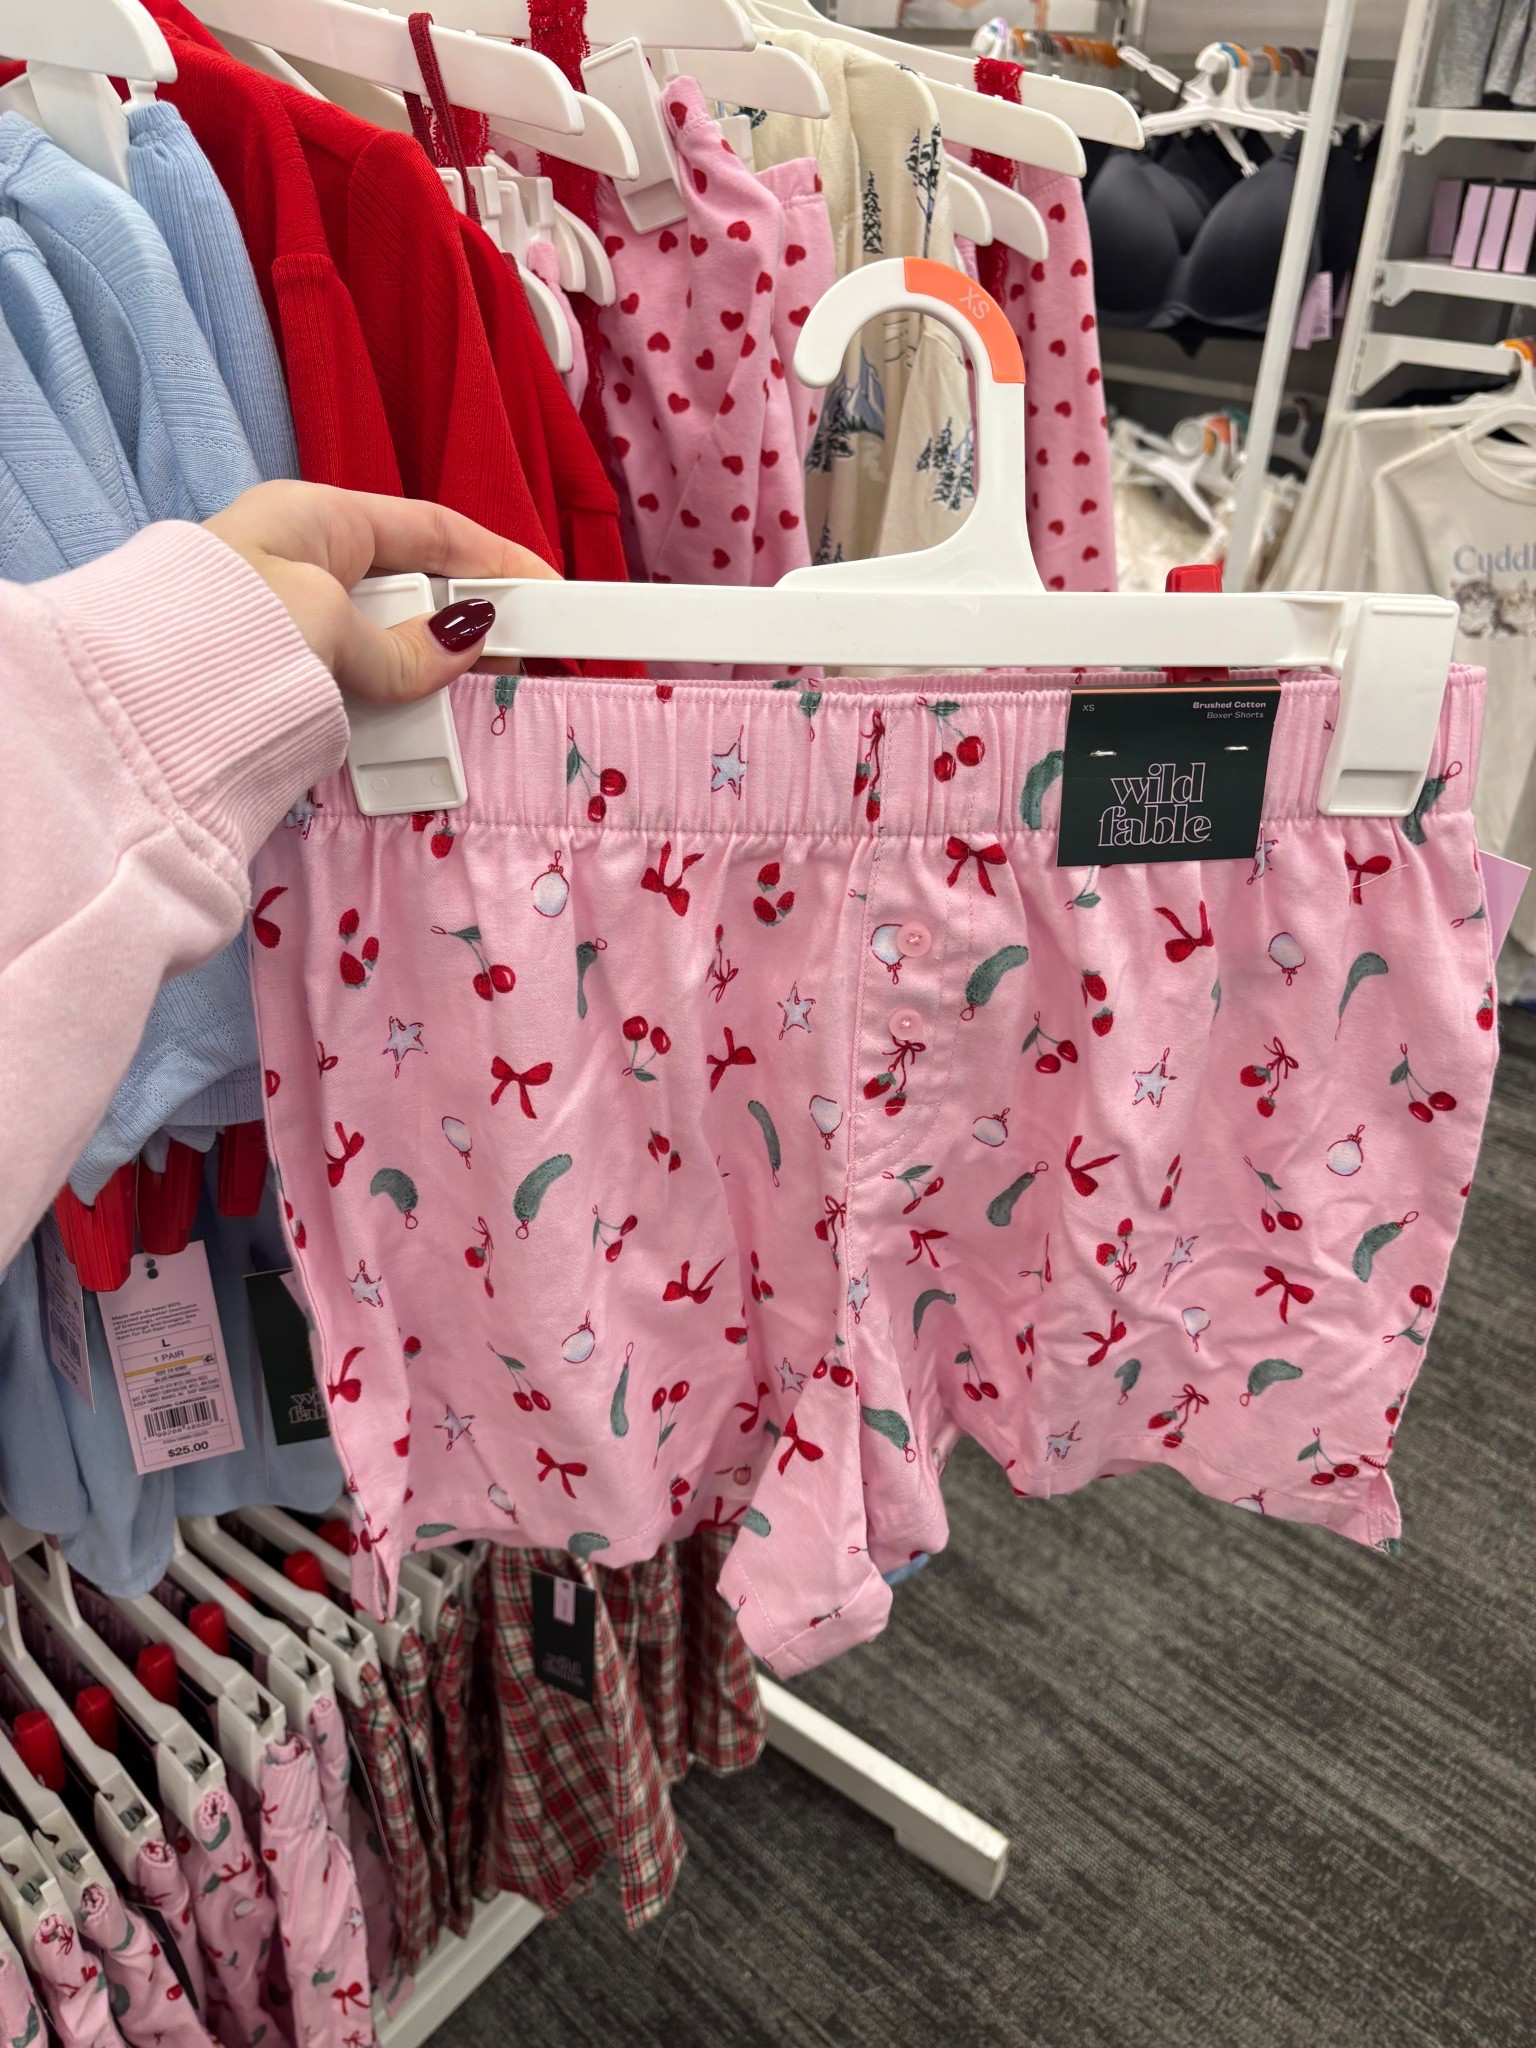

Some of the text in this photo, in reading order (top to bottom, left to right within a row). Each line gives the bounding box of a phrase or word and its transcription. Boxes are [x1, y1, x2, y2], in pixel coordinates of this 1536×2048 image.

[959, 286, 991, 320] XS
[1111, 762, 1206, 805] wild
[1098, 804, 1211, 846] fable
[161, 1337, 170, 1347] L
[161, 1349, 184, 1360] PAIR
[167, 1440, 209, 1458] $25.00
